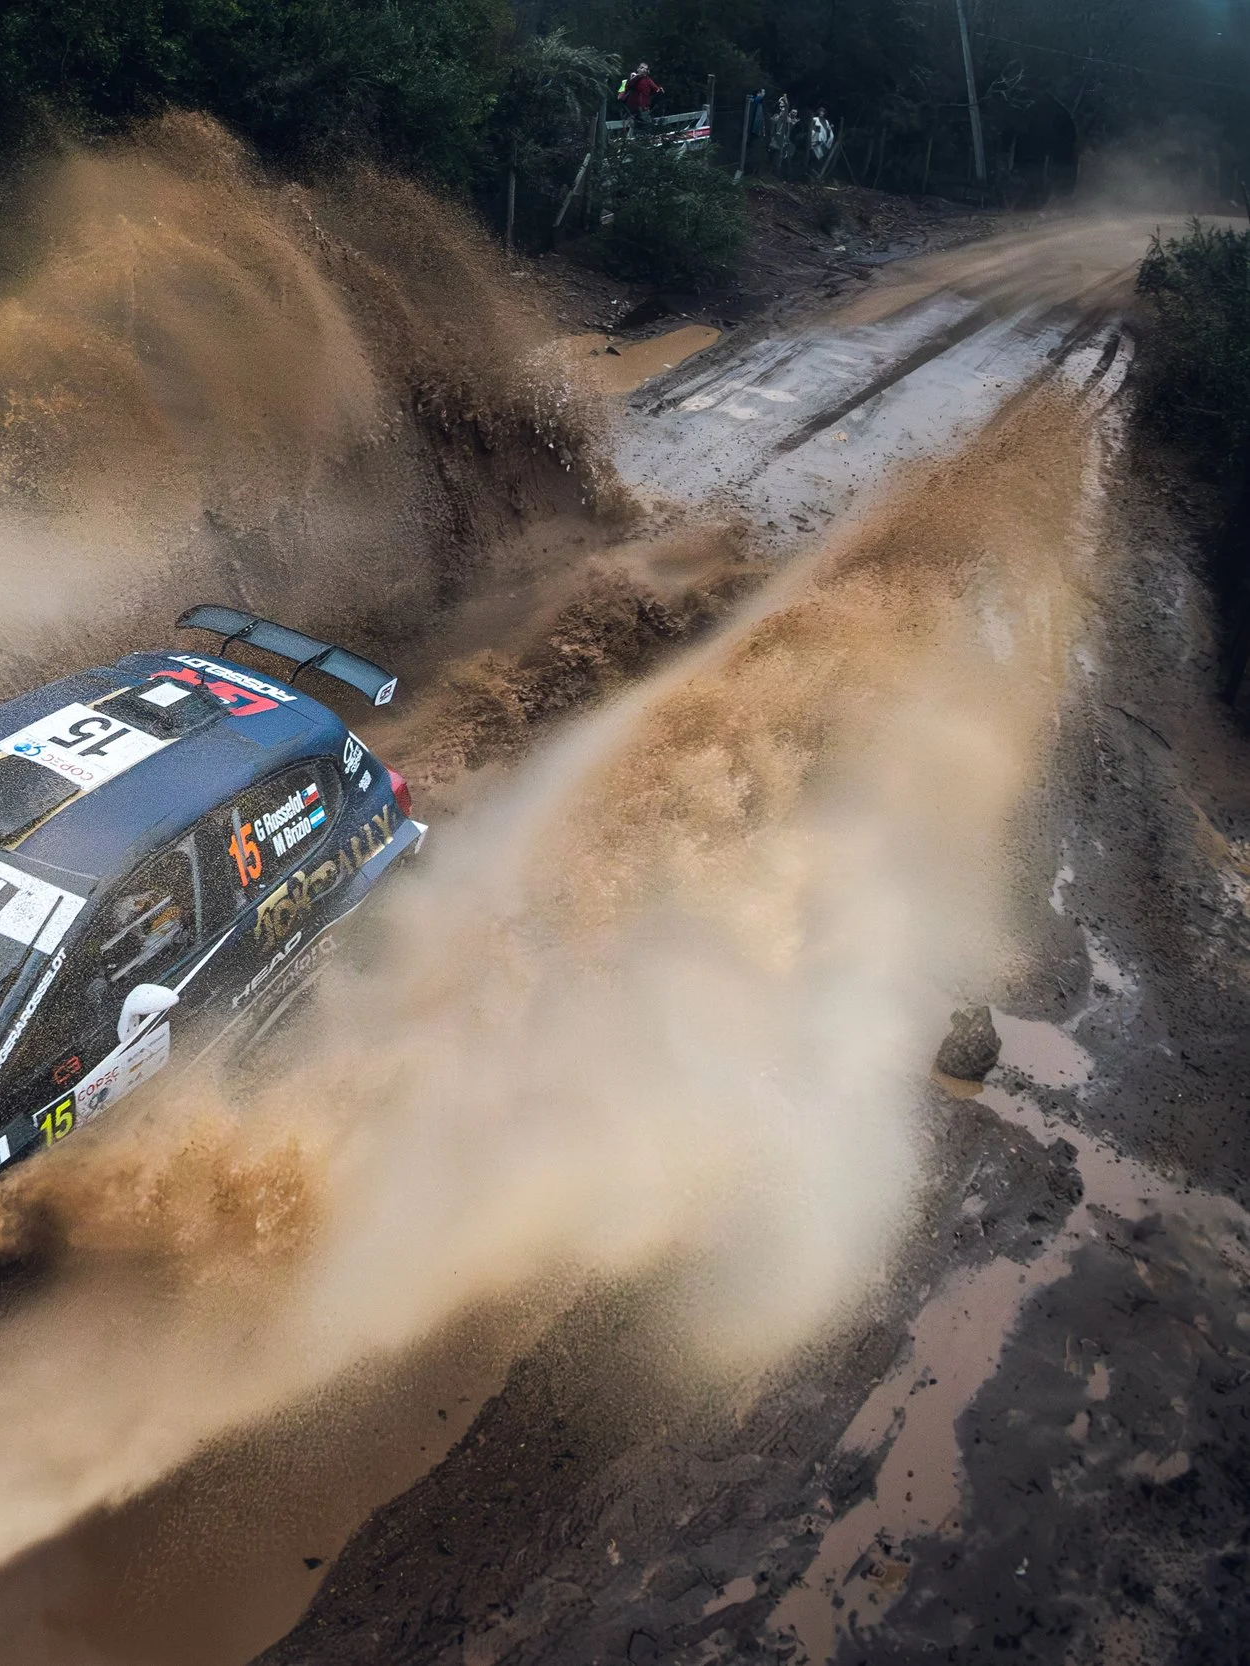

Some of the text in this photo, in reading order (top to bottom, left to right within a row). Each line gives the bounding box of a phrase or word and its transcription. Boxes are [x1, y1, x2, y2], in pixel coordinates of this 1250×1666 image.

[167, 655, 298, 702] ROSSELOT
[49, 716, 132, 758] 15
[40, 753, 95, 783] COPEC
[253, 790, 306, 842] G Rosselot
[272, 817, 312, 858] M Brizio
[228, 822, 263, 887] 15
[232, 930, 303, 1009] HEAD
[77, 1066, 120, 1102] COPEC
[39, 1098, 73, 1147] 15
